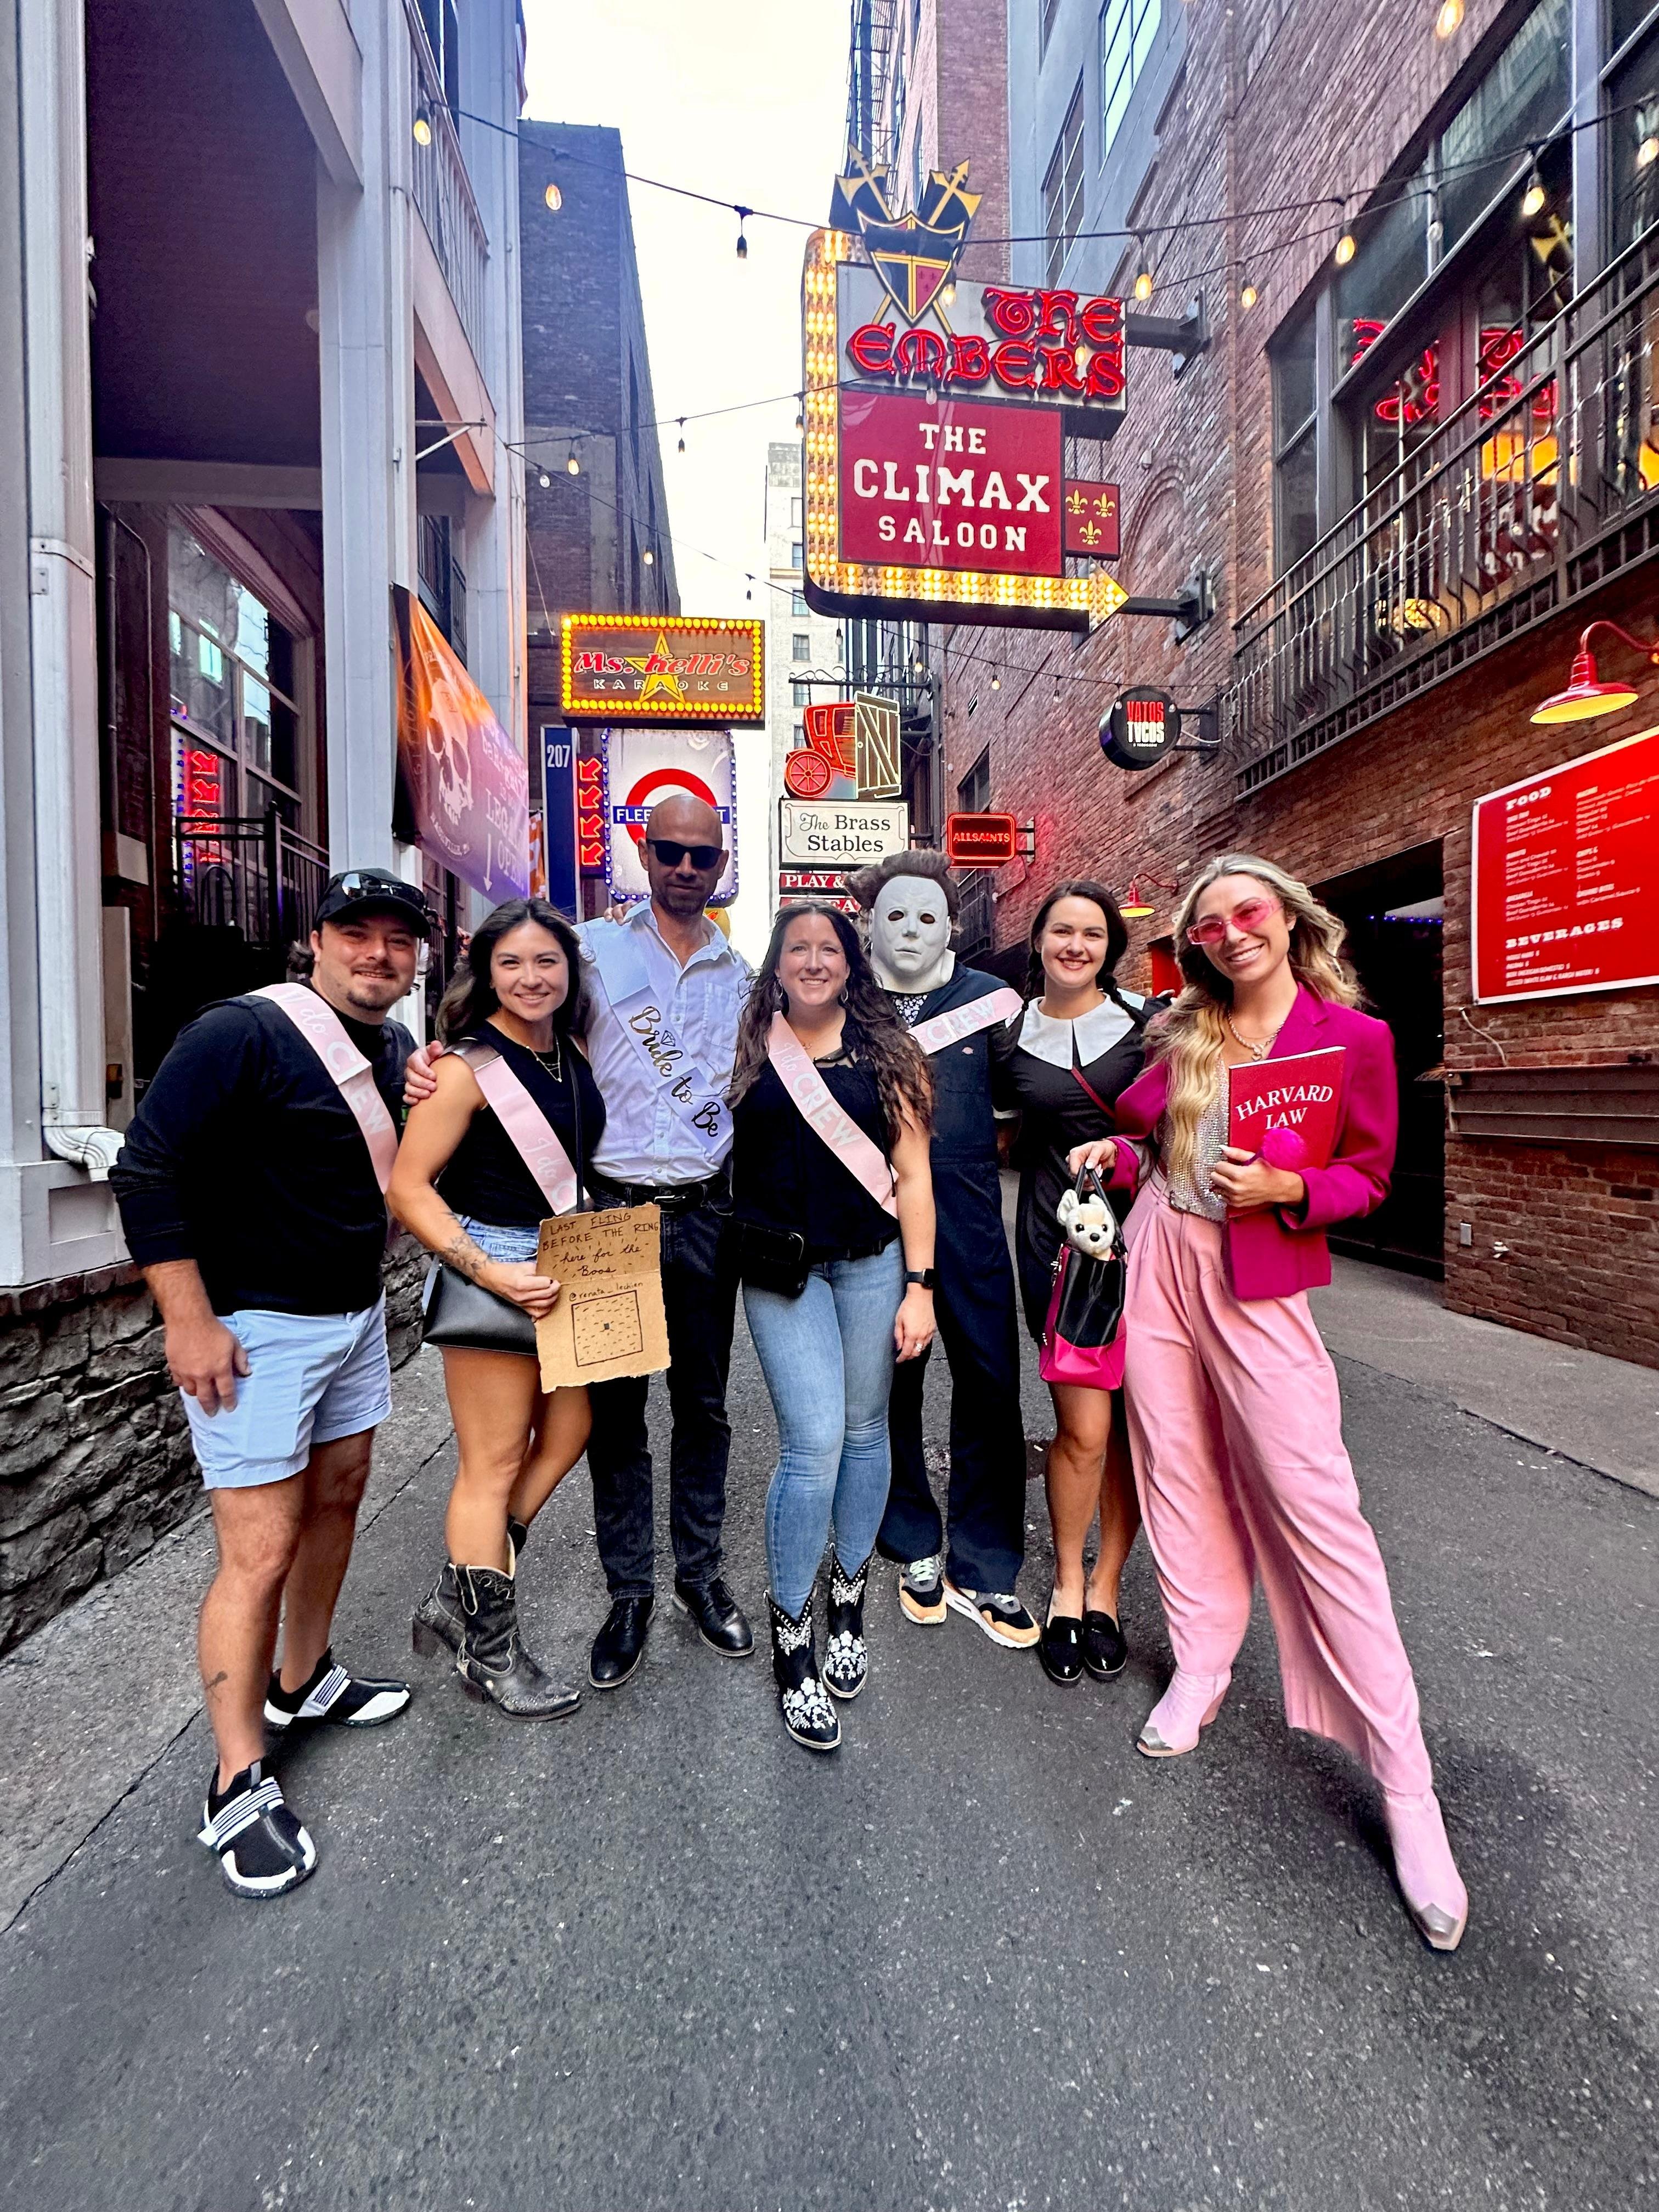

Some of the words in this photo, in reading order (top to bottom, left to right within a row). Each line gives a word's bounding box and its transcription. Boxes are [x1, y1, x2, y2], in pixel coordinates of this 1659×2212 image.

[983, 286, 1123, 346] THE
[848, 323, 1125, 400] EMBERS
[919, 422, 987, 455] THE
[854, 459, 1049, 512] CLIMAX
[879, 515, 1027, 551] SALOON
[574, 652, 634, 674] Ms.
[644, 653, 751, 676] Kelli's
[594, 679, 729, 691] KARAOKE
[1126, 701, 1164, 721] VATOS
[1127, 721, 1165, 743] TACOS
[546, 744, 571, 768] 207
[1506, 786, 1552, 811] FOOD
[617, 809, 651, 821] FLEE
[800, 812, 830, 831] The
[834, 815, 890, 831] Brass
[808, 835, 883, 852] Stables
[953, 832, 1010, 843] ALLSAINTS
[785, 875, 831, 888] PLAY
[833, 876, 844, 888] &
[1505, 917, 1624, 949] BEVERAGES
[300, 1009, 331, 1034] do
[629, 1006, 683, 1077] Bride
[672, 1076, 693, 1104] to
[692, 1102, 720, 1137] Be
[781, 1054, 806, 1071] do
[793, 1073, 862, 1147] CREW
[1235, 1085, 1333, 1121] HARVARD
[1266, 1107, 1307, 1130] LAW
[537, 1156, 566, 1178] do
[550, 1221, 576, 1235] LAST
[590, 1212, 631, 1226] FLING
[543, 1233, 592, 1251] BEFORE
[603, 1226, 623, 1237] THE
[634, 1223, 658, 1234] RING
[560, 1253, 585, 1265] here
[592, 1248, 613, 1262] for
[620, 1244, 642, 1254] the
